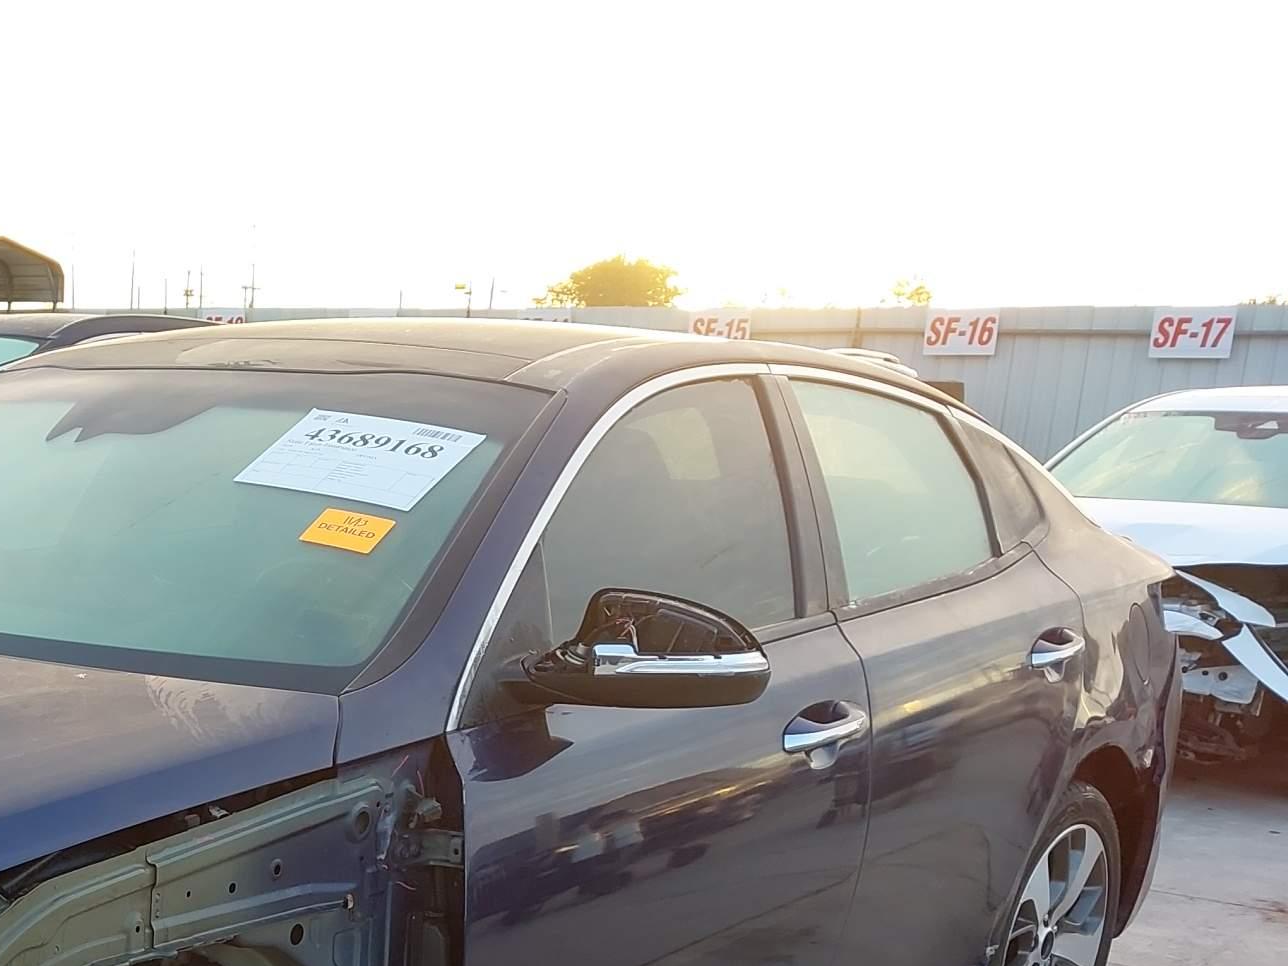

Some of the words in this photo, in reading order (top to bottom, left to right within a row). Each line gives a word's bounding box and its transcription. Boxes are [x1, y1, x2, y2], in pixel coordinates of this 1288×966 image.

[926, 316, 997, 346] SF-16
[1152, 316, 1233, 348] SF-17
[305, 427, 445, 459] 43689168
[318, 522, 376, 539] DETAILED
